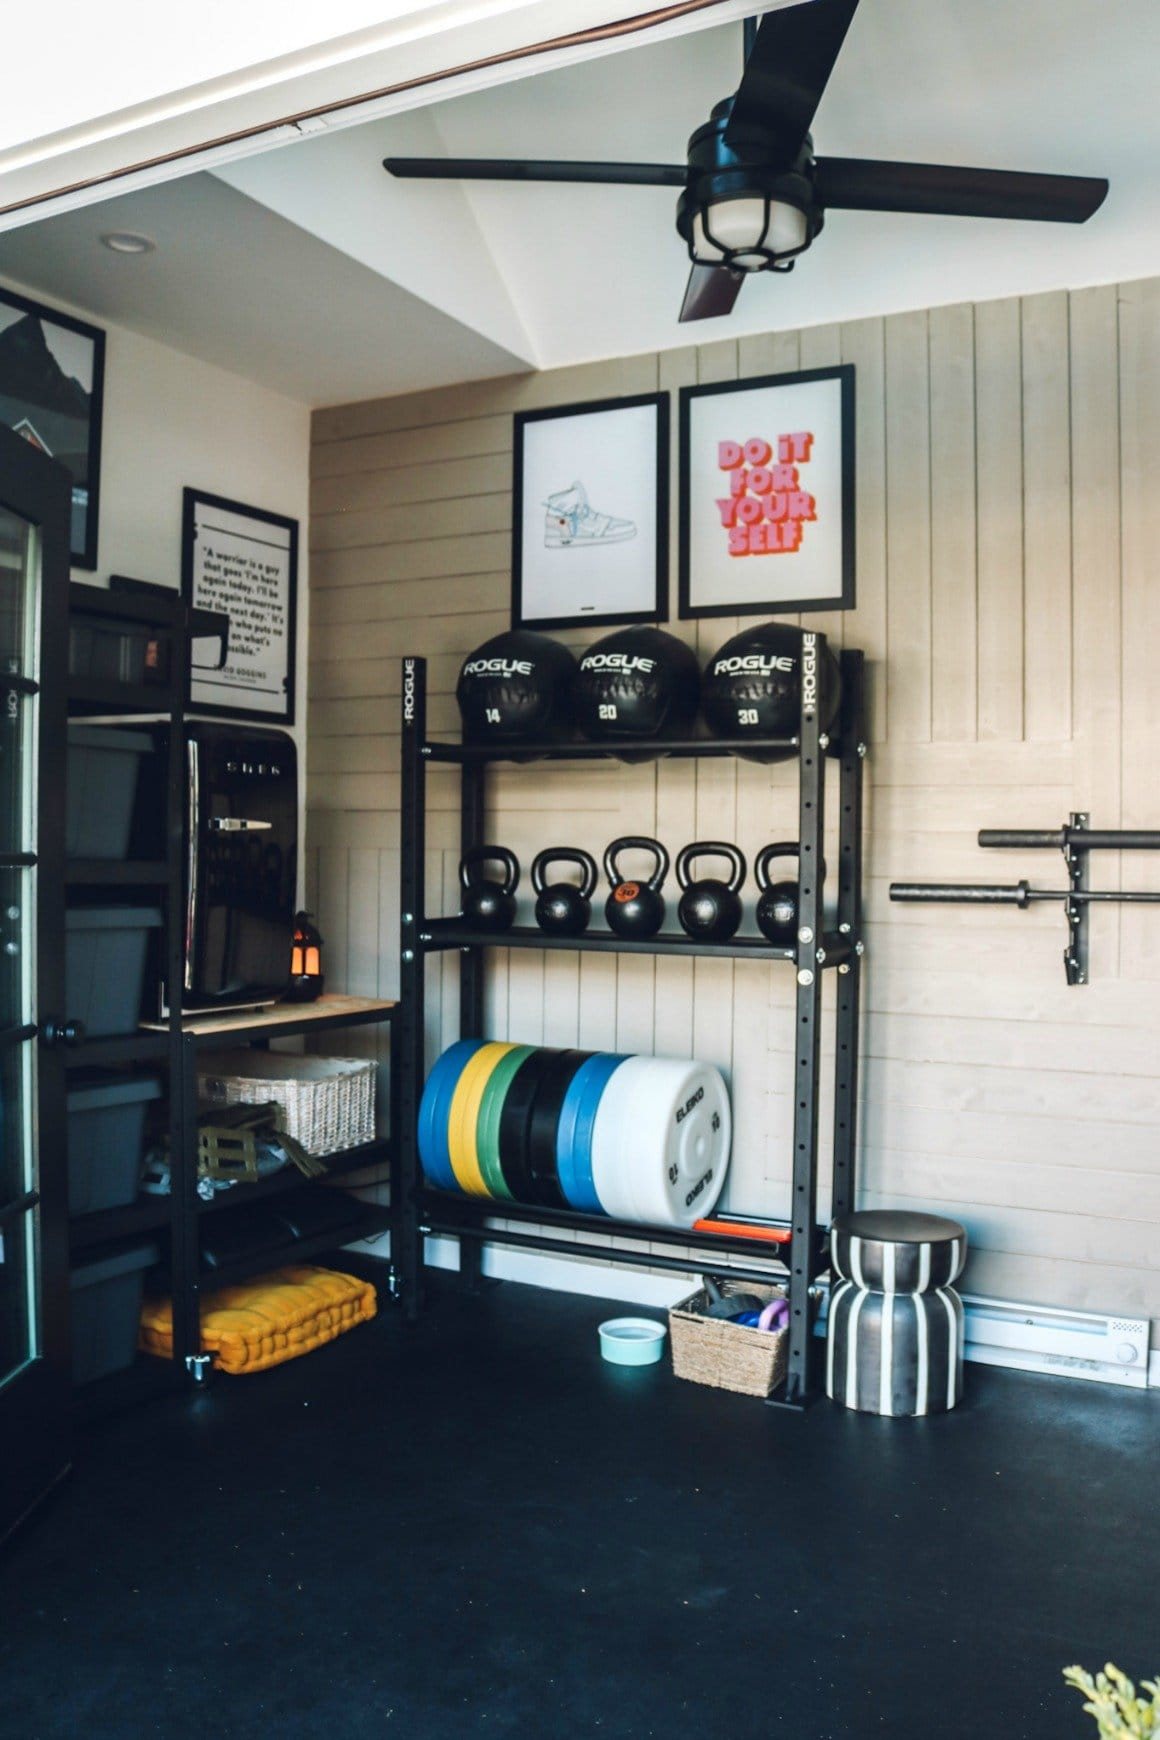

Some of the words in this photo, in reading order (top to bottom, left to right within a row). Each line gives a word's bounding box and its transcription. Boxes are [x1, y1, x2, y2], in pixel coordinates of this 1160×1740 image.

[718, 437, 772, 471] DO
[730, 464, 800, 497] FOR
[715, 491, 817, 528] YOUR
[728, 520, 803, 557] SELF
[203, 561, 221, 572] that
[223, 567, 242, 577] goes
[260, 574, 278, 586] here
[216, 552, 247, 566] warrior
[249, 558, 256, 569] is
[258, 563, 263, 571] a
[265, 565, 279, 576] guy
[197, 583, 216, 597] here
[219, 591, 242, 602] again
[244, 596, 283, 612] tomorrow
[203, 575, 227, 586] again
[269, 588, 278, 598] be
[196, 600, 213, 609] and
[215, 602, 228, 612] the
[230, 606, 248, 616] next
[235, 620, 252, 630] who
[254, 624, 271, 634] puts
[272, 628, 282, 637] no
[464, 658, 534, 676] ROGUE
[580, 654, 656, 673] ROGUE
[714, 655, 796, 676] ROGUE
[803, 633, 817, 704] ROGUE
[404, 659, 415, 720] ROGUE
[485, 708, 501, 723] 14
[598, 704, 617, 720] 20
[738, 708, 759, 725] 30
[676, 1086, 705, 1124] ELEIKO
